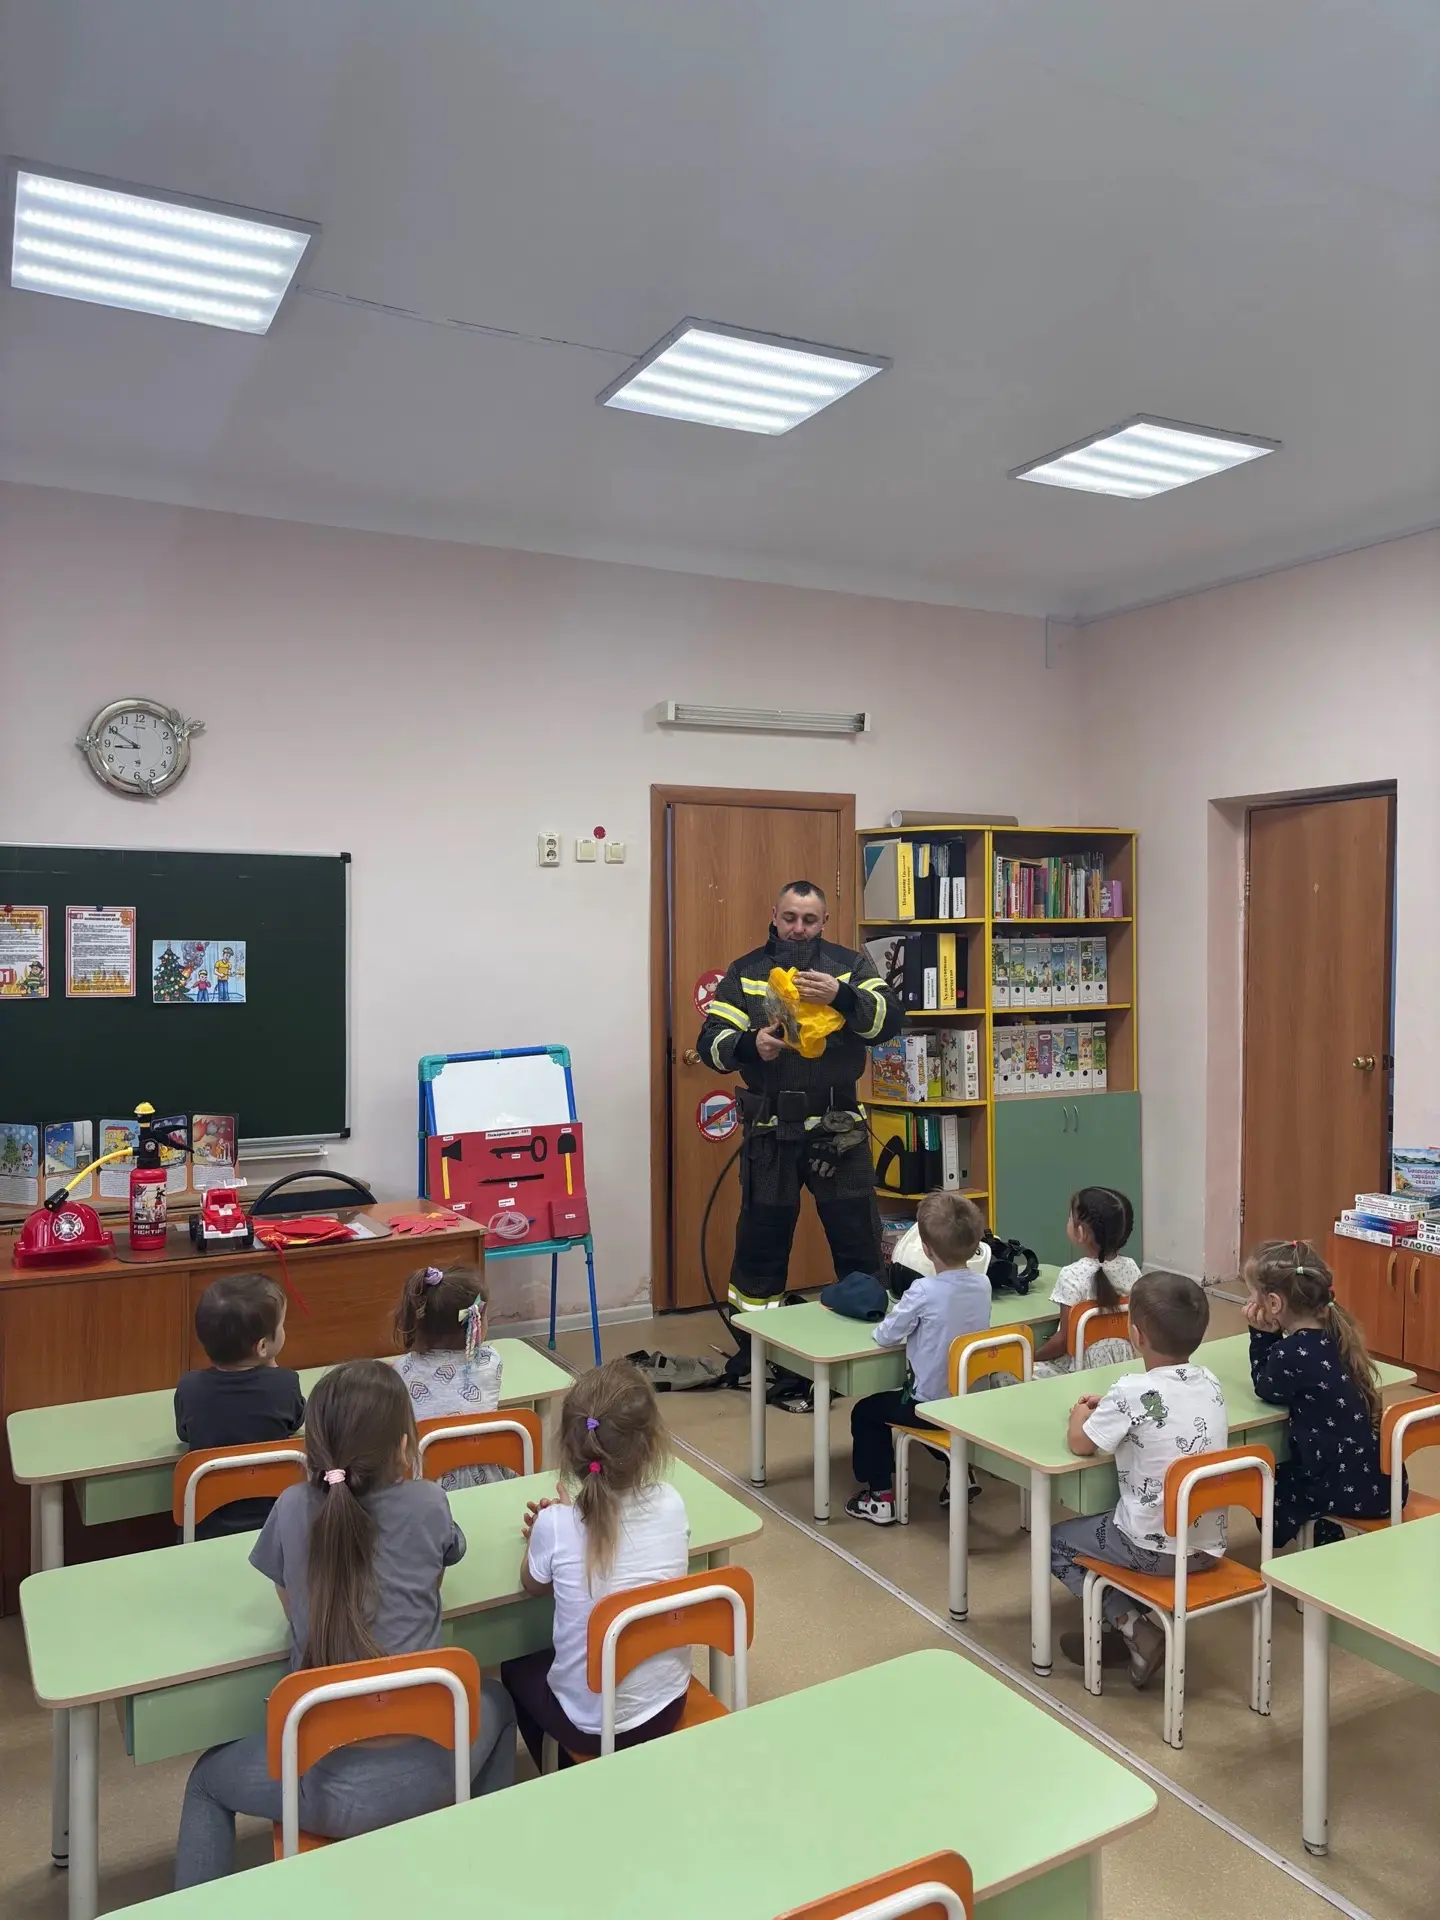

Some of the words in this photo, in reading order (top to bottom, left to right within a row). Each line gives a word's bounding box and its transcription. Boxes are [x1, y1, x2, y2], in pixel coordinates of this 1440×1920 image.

[120, 716, 128, 724] 11
[136, 714, 146, 724] 12
[153, 720, 158, 728] 1
[108, 726, 118, 734] 10
[162, 732, 169, 740] 2
[104, 740, 111, 748] 9
[166, 746, 172, 754] 3
[108, 754, 114, 763] 8
[160, 760, 167, 768] 4
[118, 766, 125, 774] 7
[149, 770, 156, 778] 5
[134, 772, 140, 780] 6
[1410, 1241, 1434, 1252] ЛОТО
